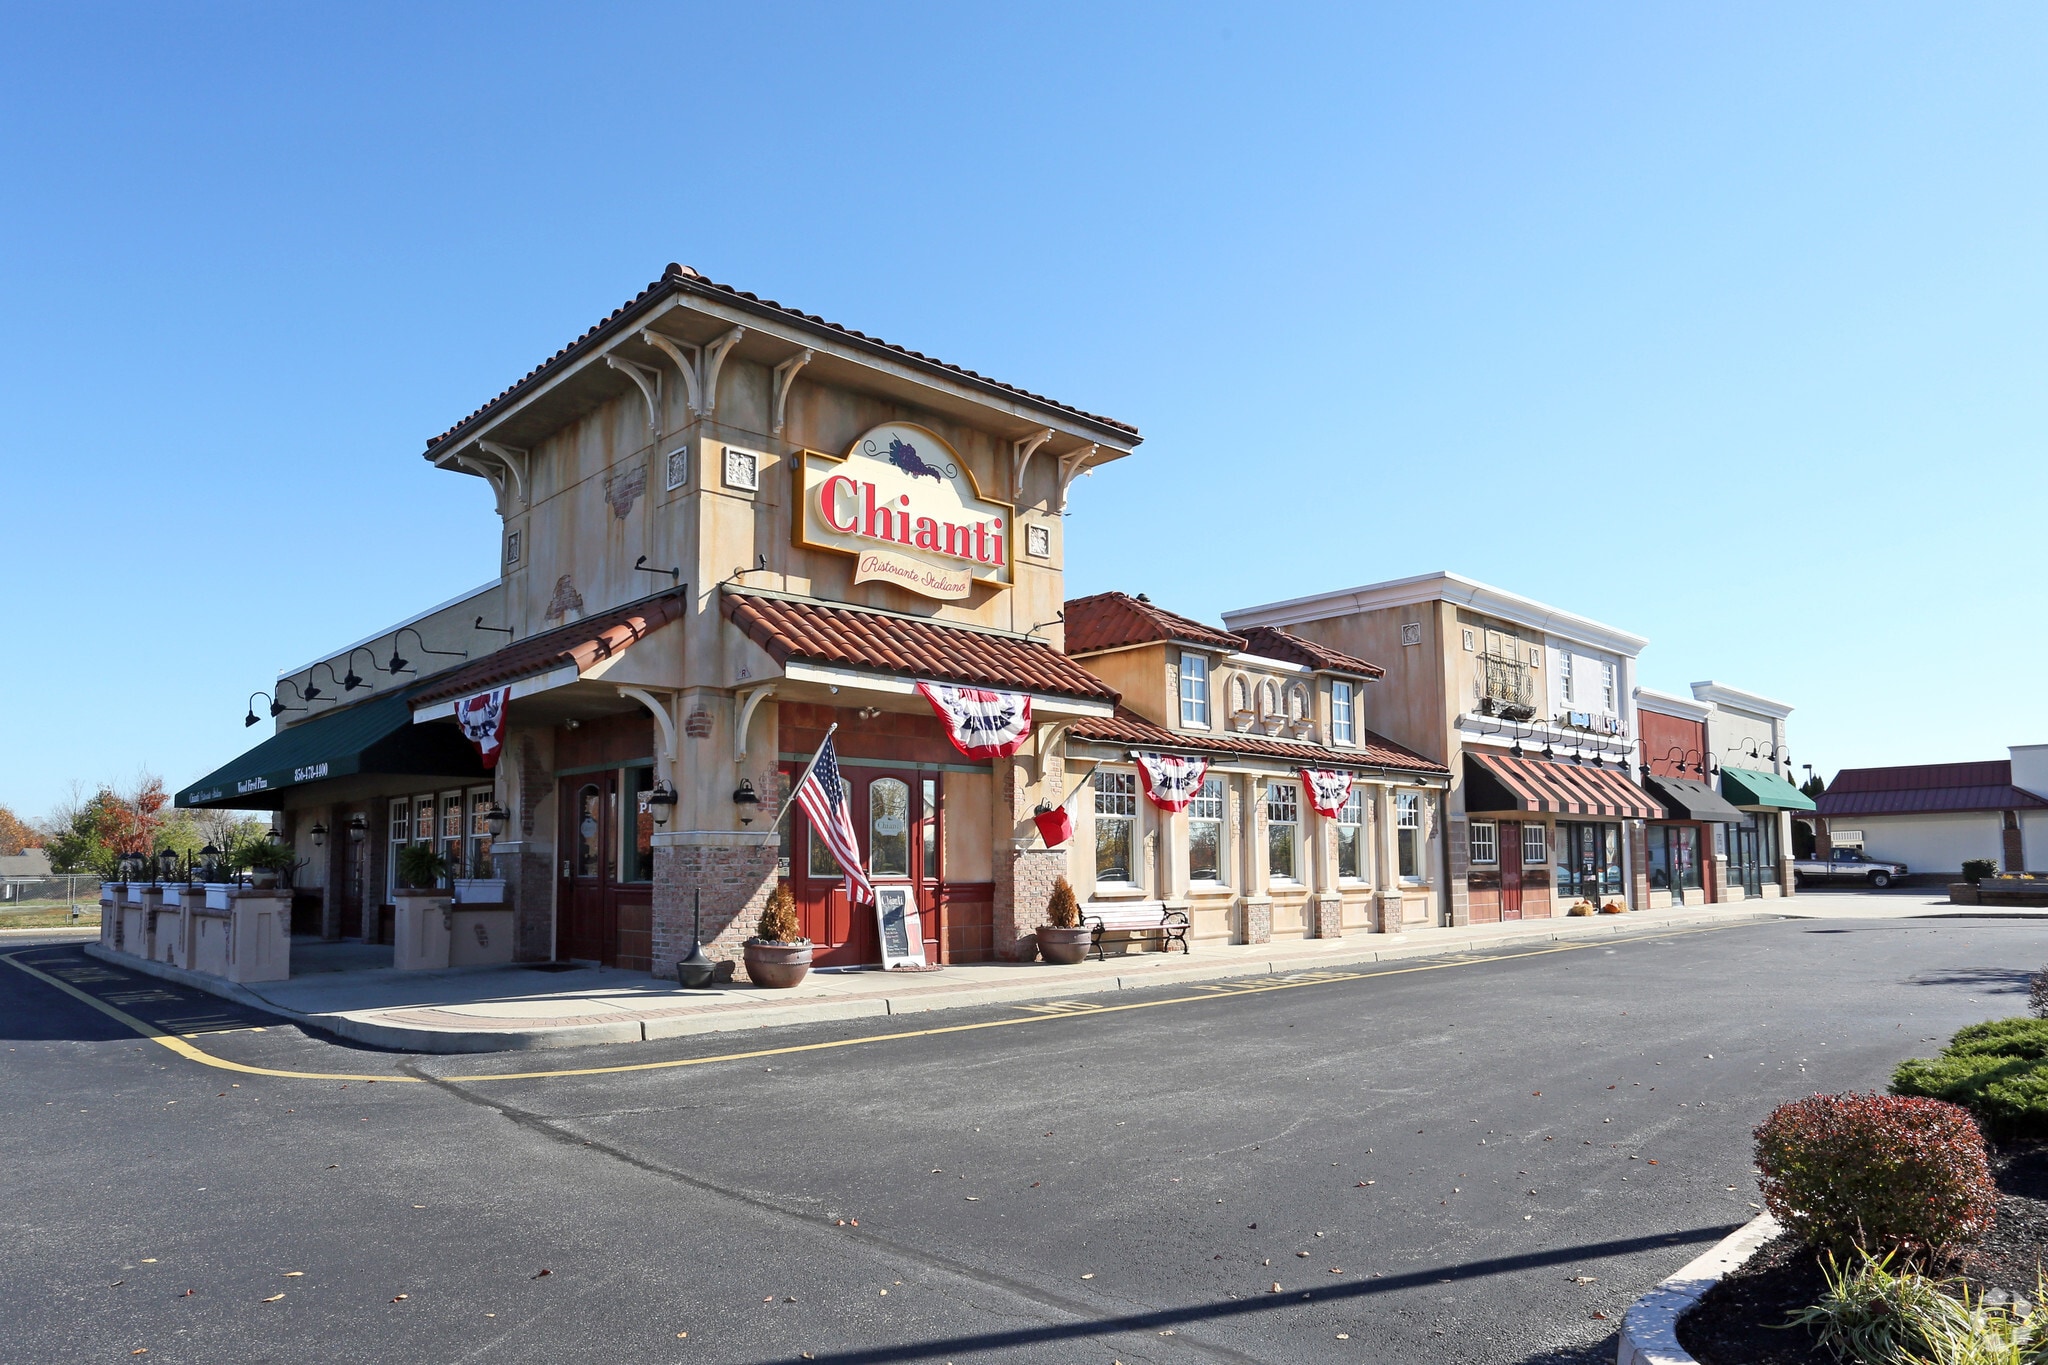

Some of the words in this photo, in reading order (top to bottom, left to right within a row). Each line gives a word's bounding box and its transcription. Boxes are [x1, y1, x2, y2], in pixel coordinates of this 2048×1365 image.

[818, 474, 1006, 567] Chianti
[860, 556, 920, 582] Ristorante
[920, 571, 967, 593] Italiano
[294, 762, 329, 782] 856-478-4400
